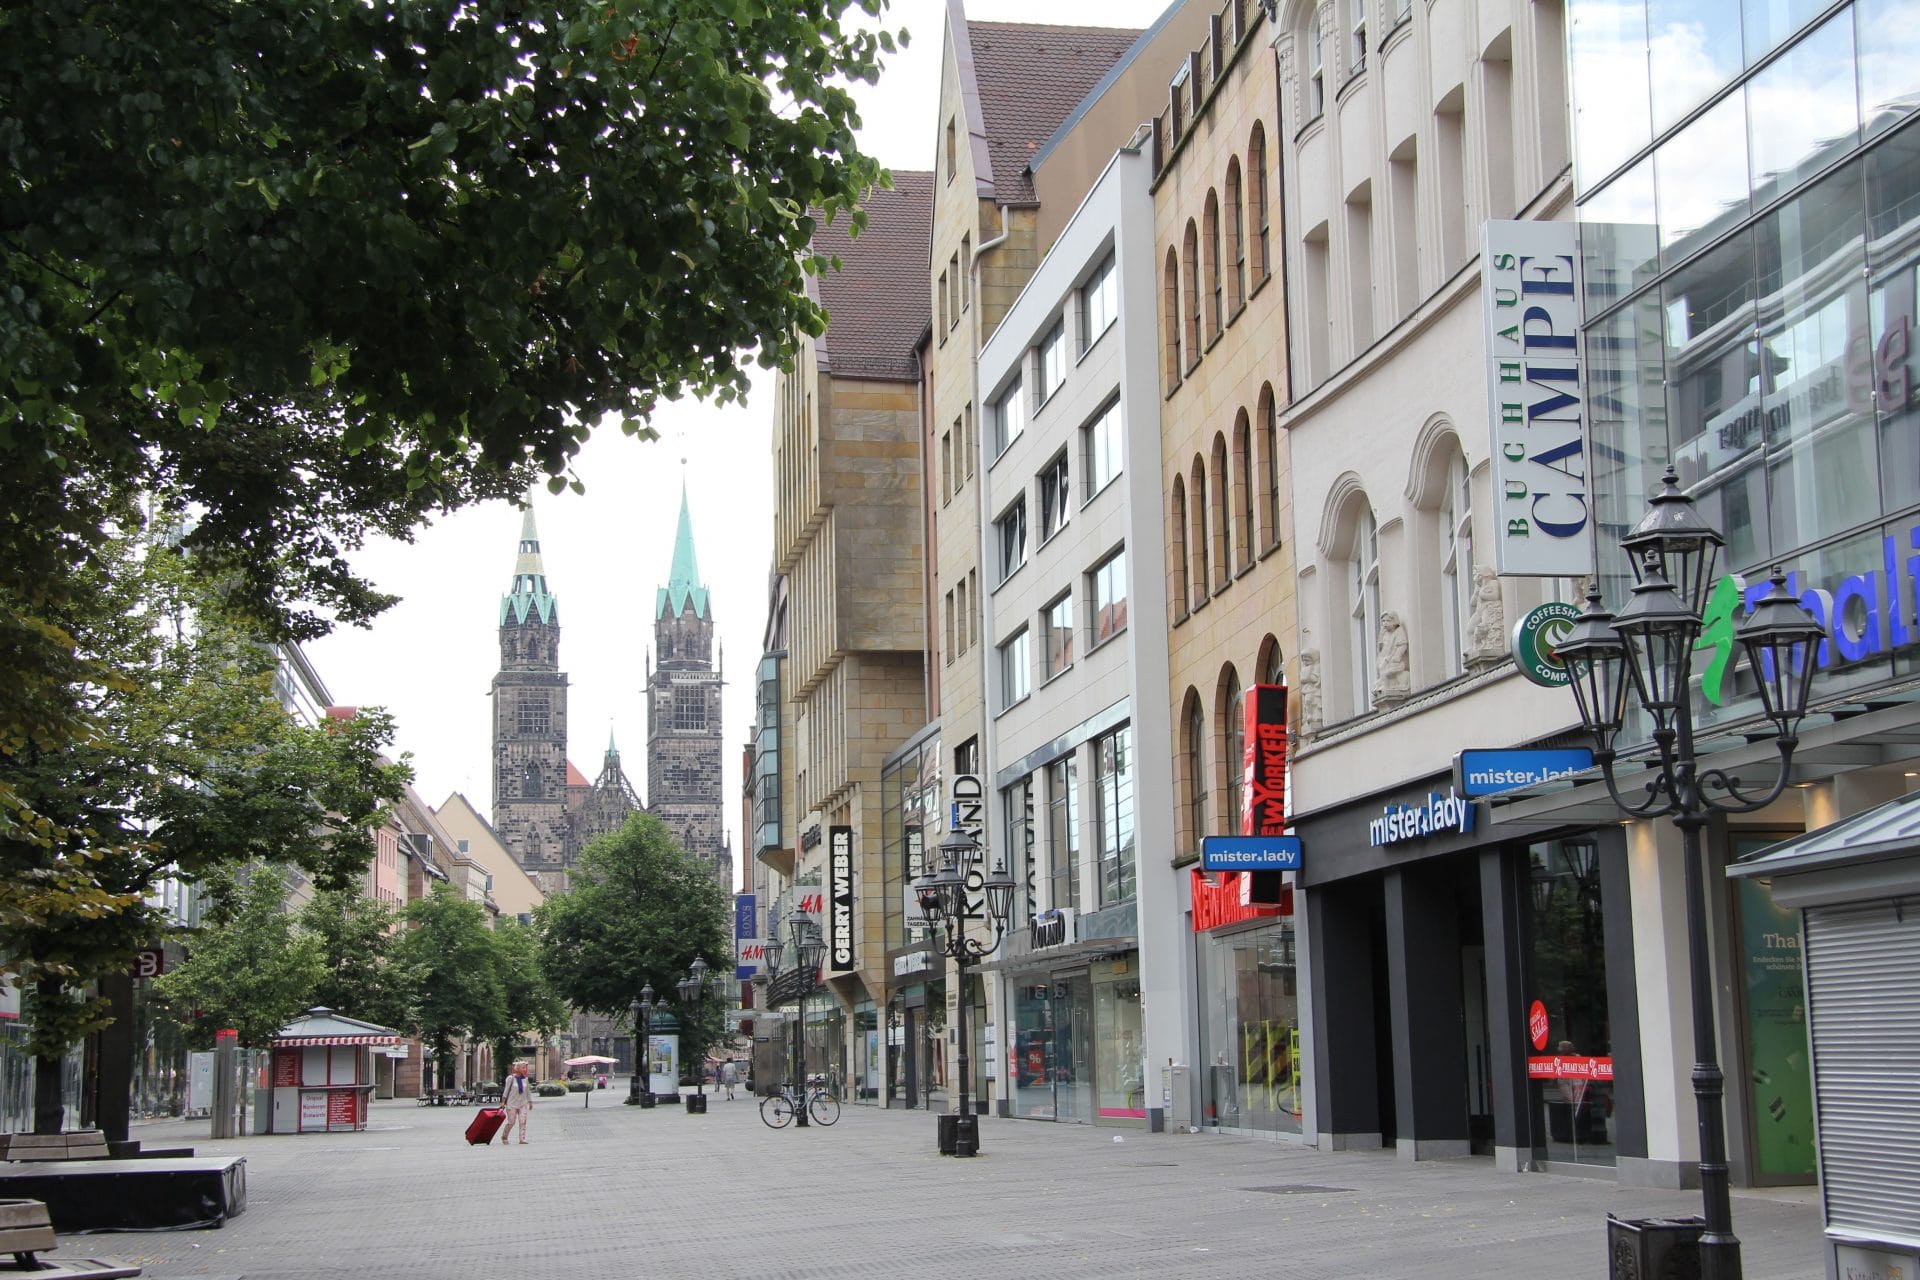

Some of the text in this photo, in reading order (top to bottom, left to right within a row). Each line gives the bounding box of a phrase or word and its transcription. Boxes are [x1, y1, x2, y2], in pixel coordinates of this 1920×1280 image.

[1494, 252, 1530, 538] BUCHHAUS
[1519, 254, 1588, 538] CAMPE
[833, 832, 851, 964] GERRY WEBER
